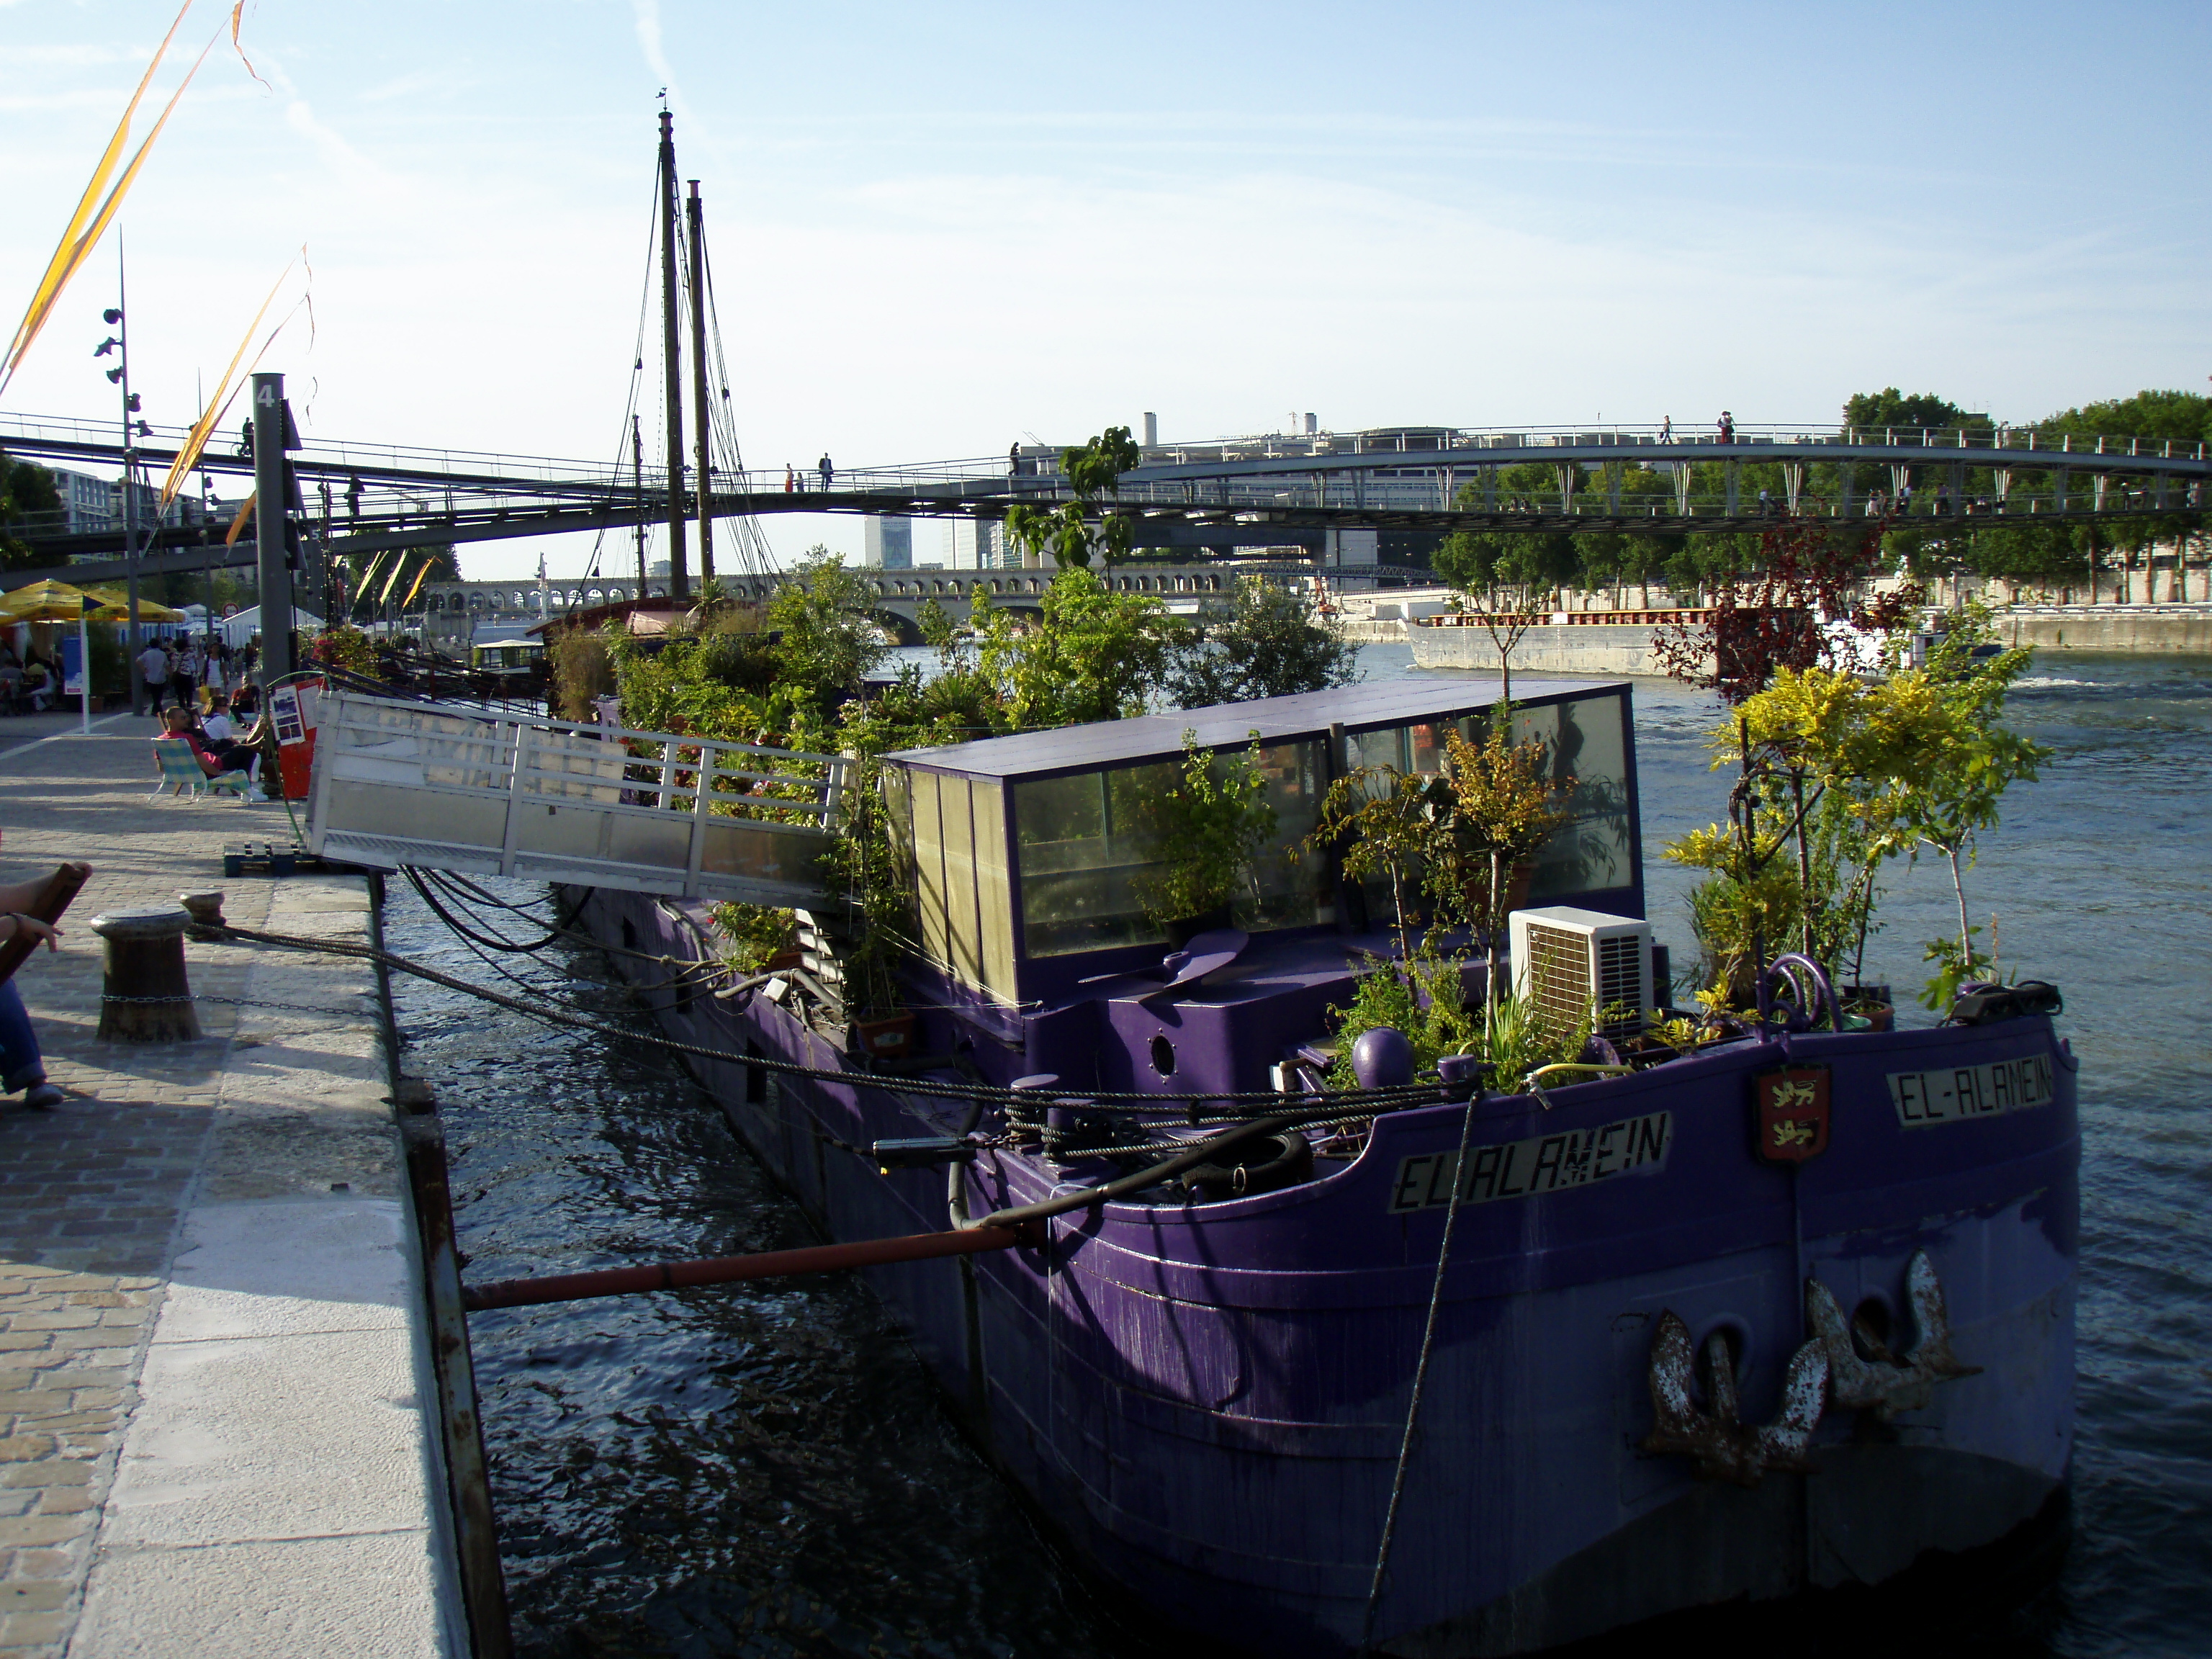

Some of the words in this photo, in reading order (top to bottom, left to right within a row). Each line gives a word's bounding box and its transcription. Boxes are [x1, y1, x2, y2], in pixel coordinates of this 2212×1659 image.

[257, 385, 275, 408] 4
[312, 529, 320, 540] 5
[1467, 1113, 1667, 1200] ALAMEIN
